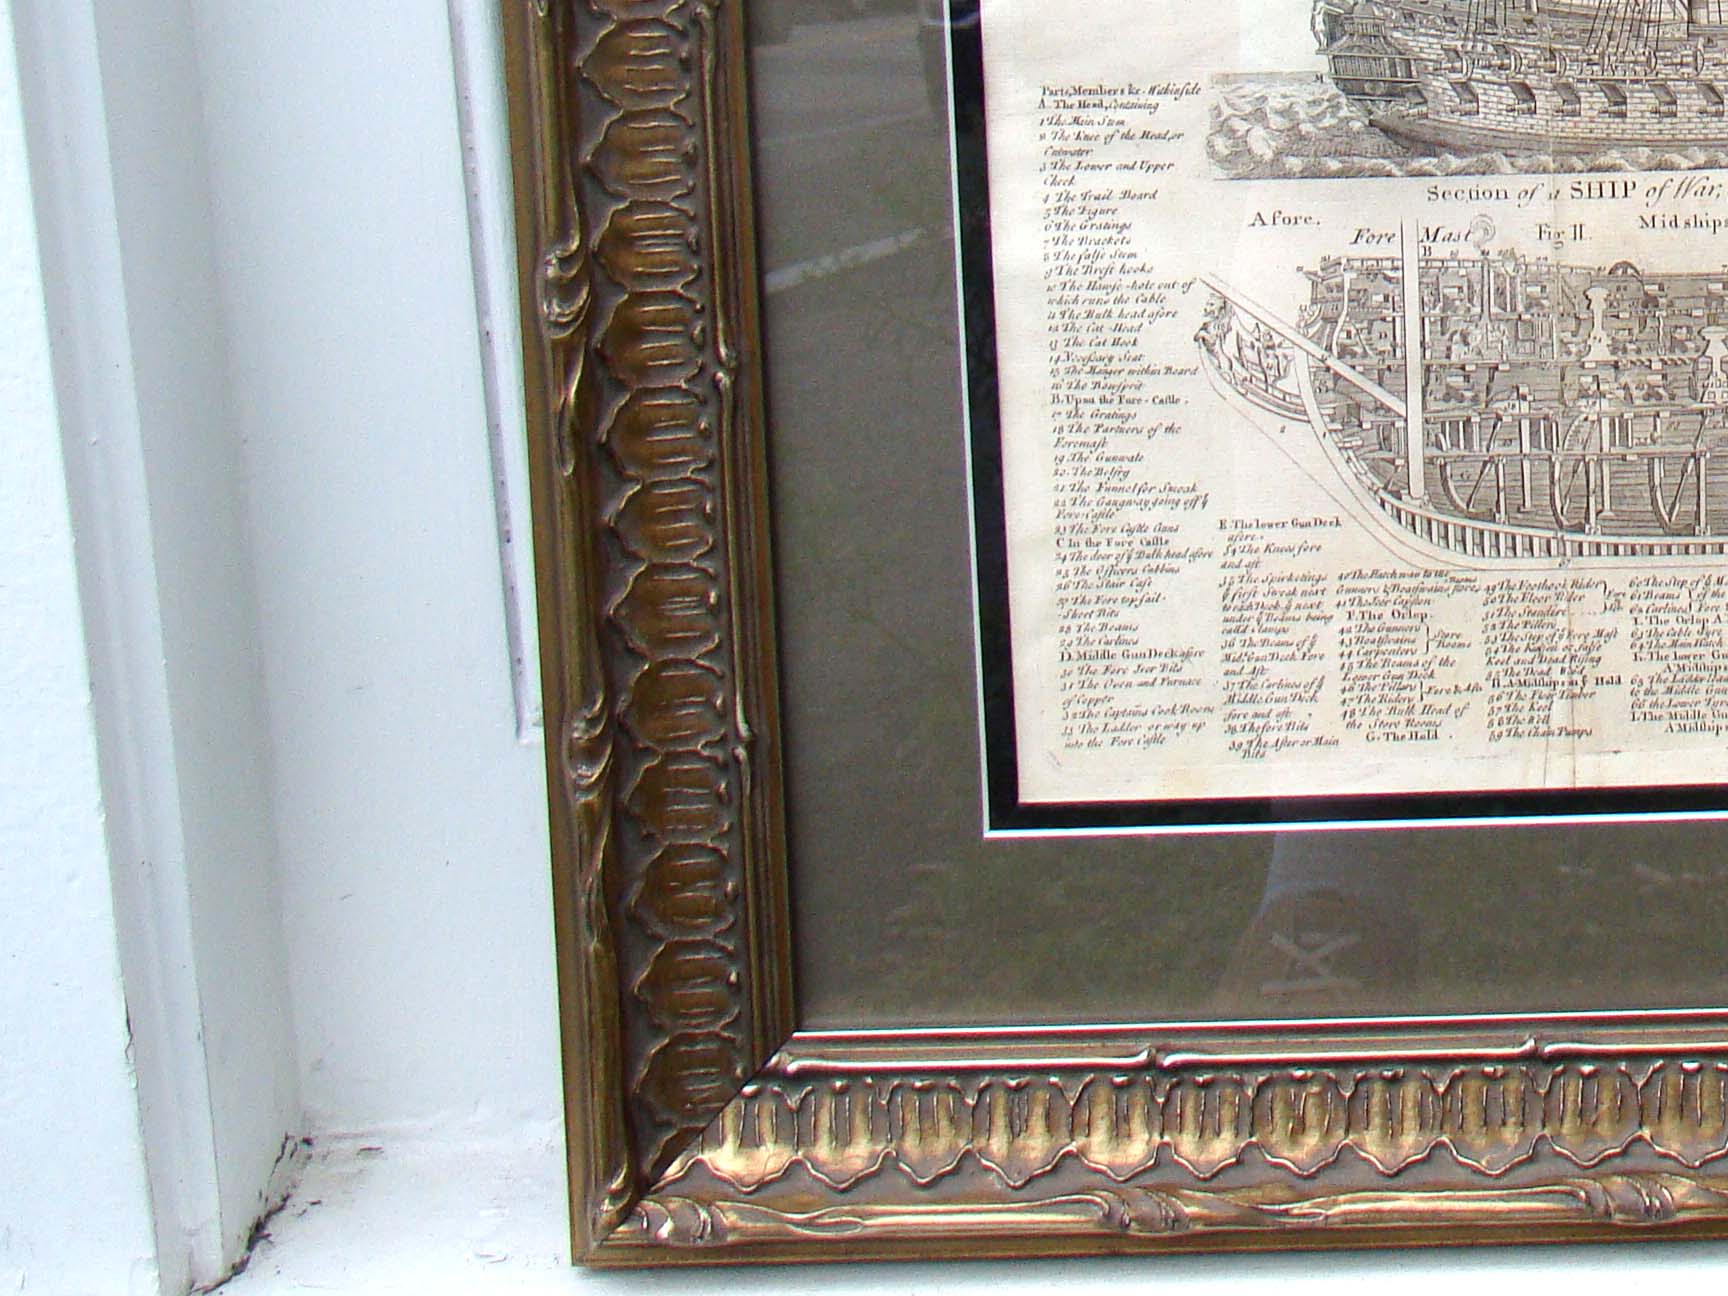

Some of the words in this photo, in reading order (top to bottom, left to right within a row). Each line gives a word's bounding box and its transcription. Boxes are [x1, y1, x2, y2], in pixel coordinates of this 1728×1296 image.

[1427, 184, 1508, 203] Section
[1517, 183, 1544, 208] of
[1571, 181, 1636, 199] SHIP
[1646, 178, 1675, 208] of
[1349, 228, 1395, 245] Fore
[1418, 226, 1473, 246] Mast
